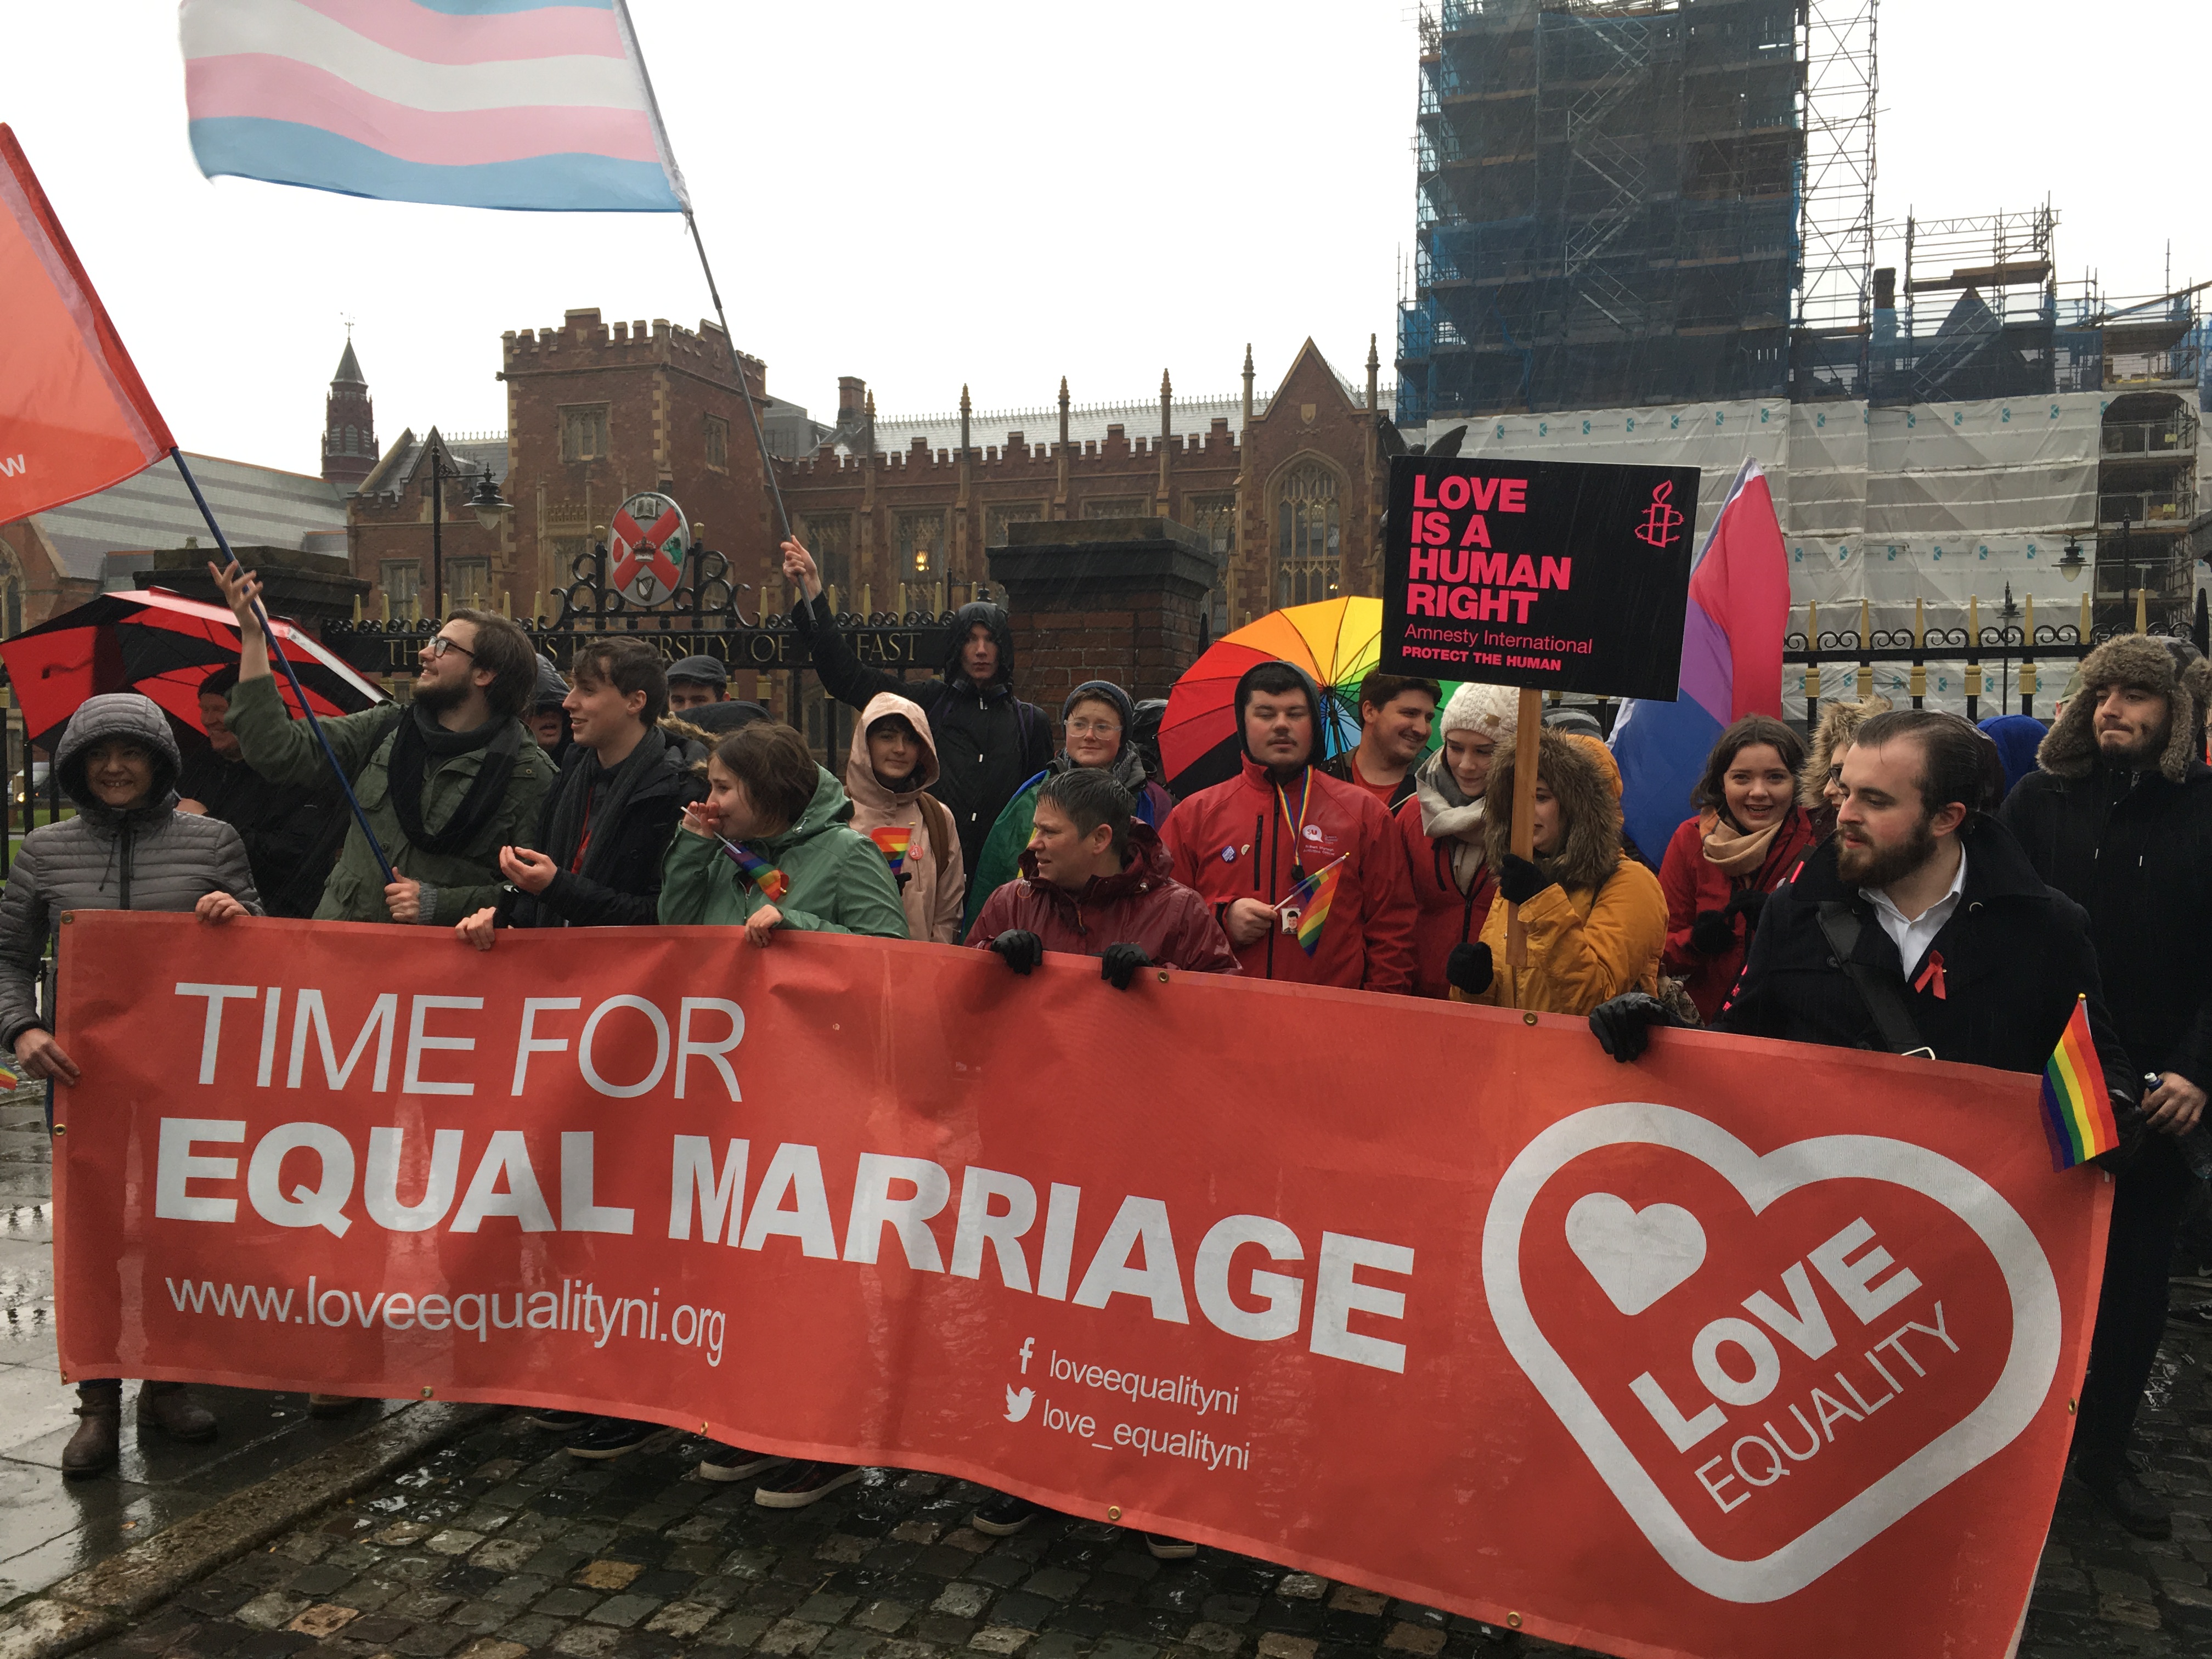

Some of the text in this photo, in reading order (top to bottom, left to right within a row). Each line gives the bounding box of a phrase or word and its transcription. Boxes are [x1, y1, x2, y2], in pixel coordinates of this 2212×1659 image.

[1413, 475, 1528, 513] LOVE
[1411, 511, 1492, 548] IS A
[1409, 547, 1572, 590] HUMAN
[1407, 583, 1538, 624] RIGHT
[751, 634, 790, 662] OF
[1402, 646, 1561, 671] PROTECT THE HUMAN
[1404, 623, 1592, 654] Amnesty International
[175, 982, 745, 1102] TIME FOR
[155, 1117, 1414, 1374] EQUAL MARRIAGE
[166, 1276, 725, 1367] www.loveequalityni.org
[1628, 1216, 1922, 1454] LOVE
[1050, 1350, 1238, 1415] loveequalityni
[1694, 1301, 1960, 1514] EQUALITY
[1043, 1399, 1249, 1470] love_equalityni
